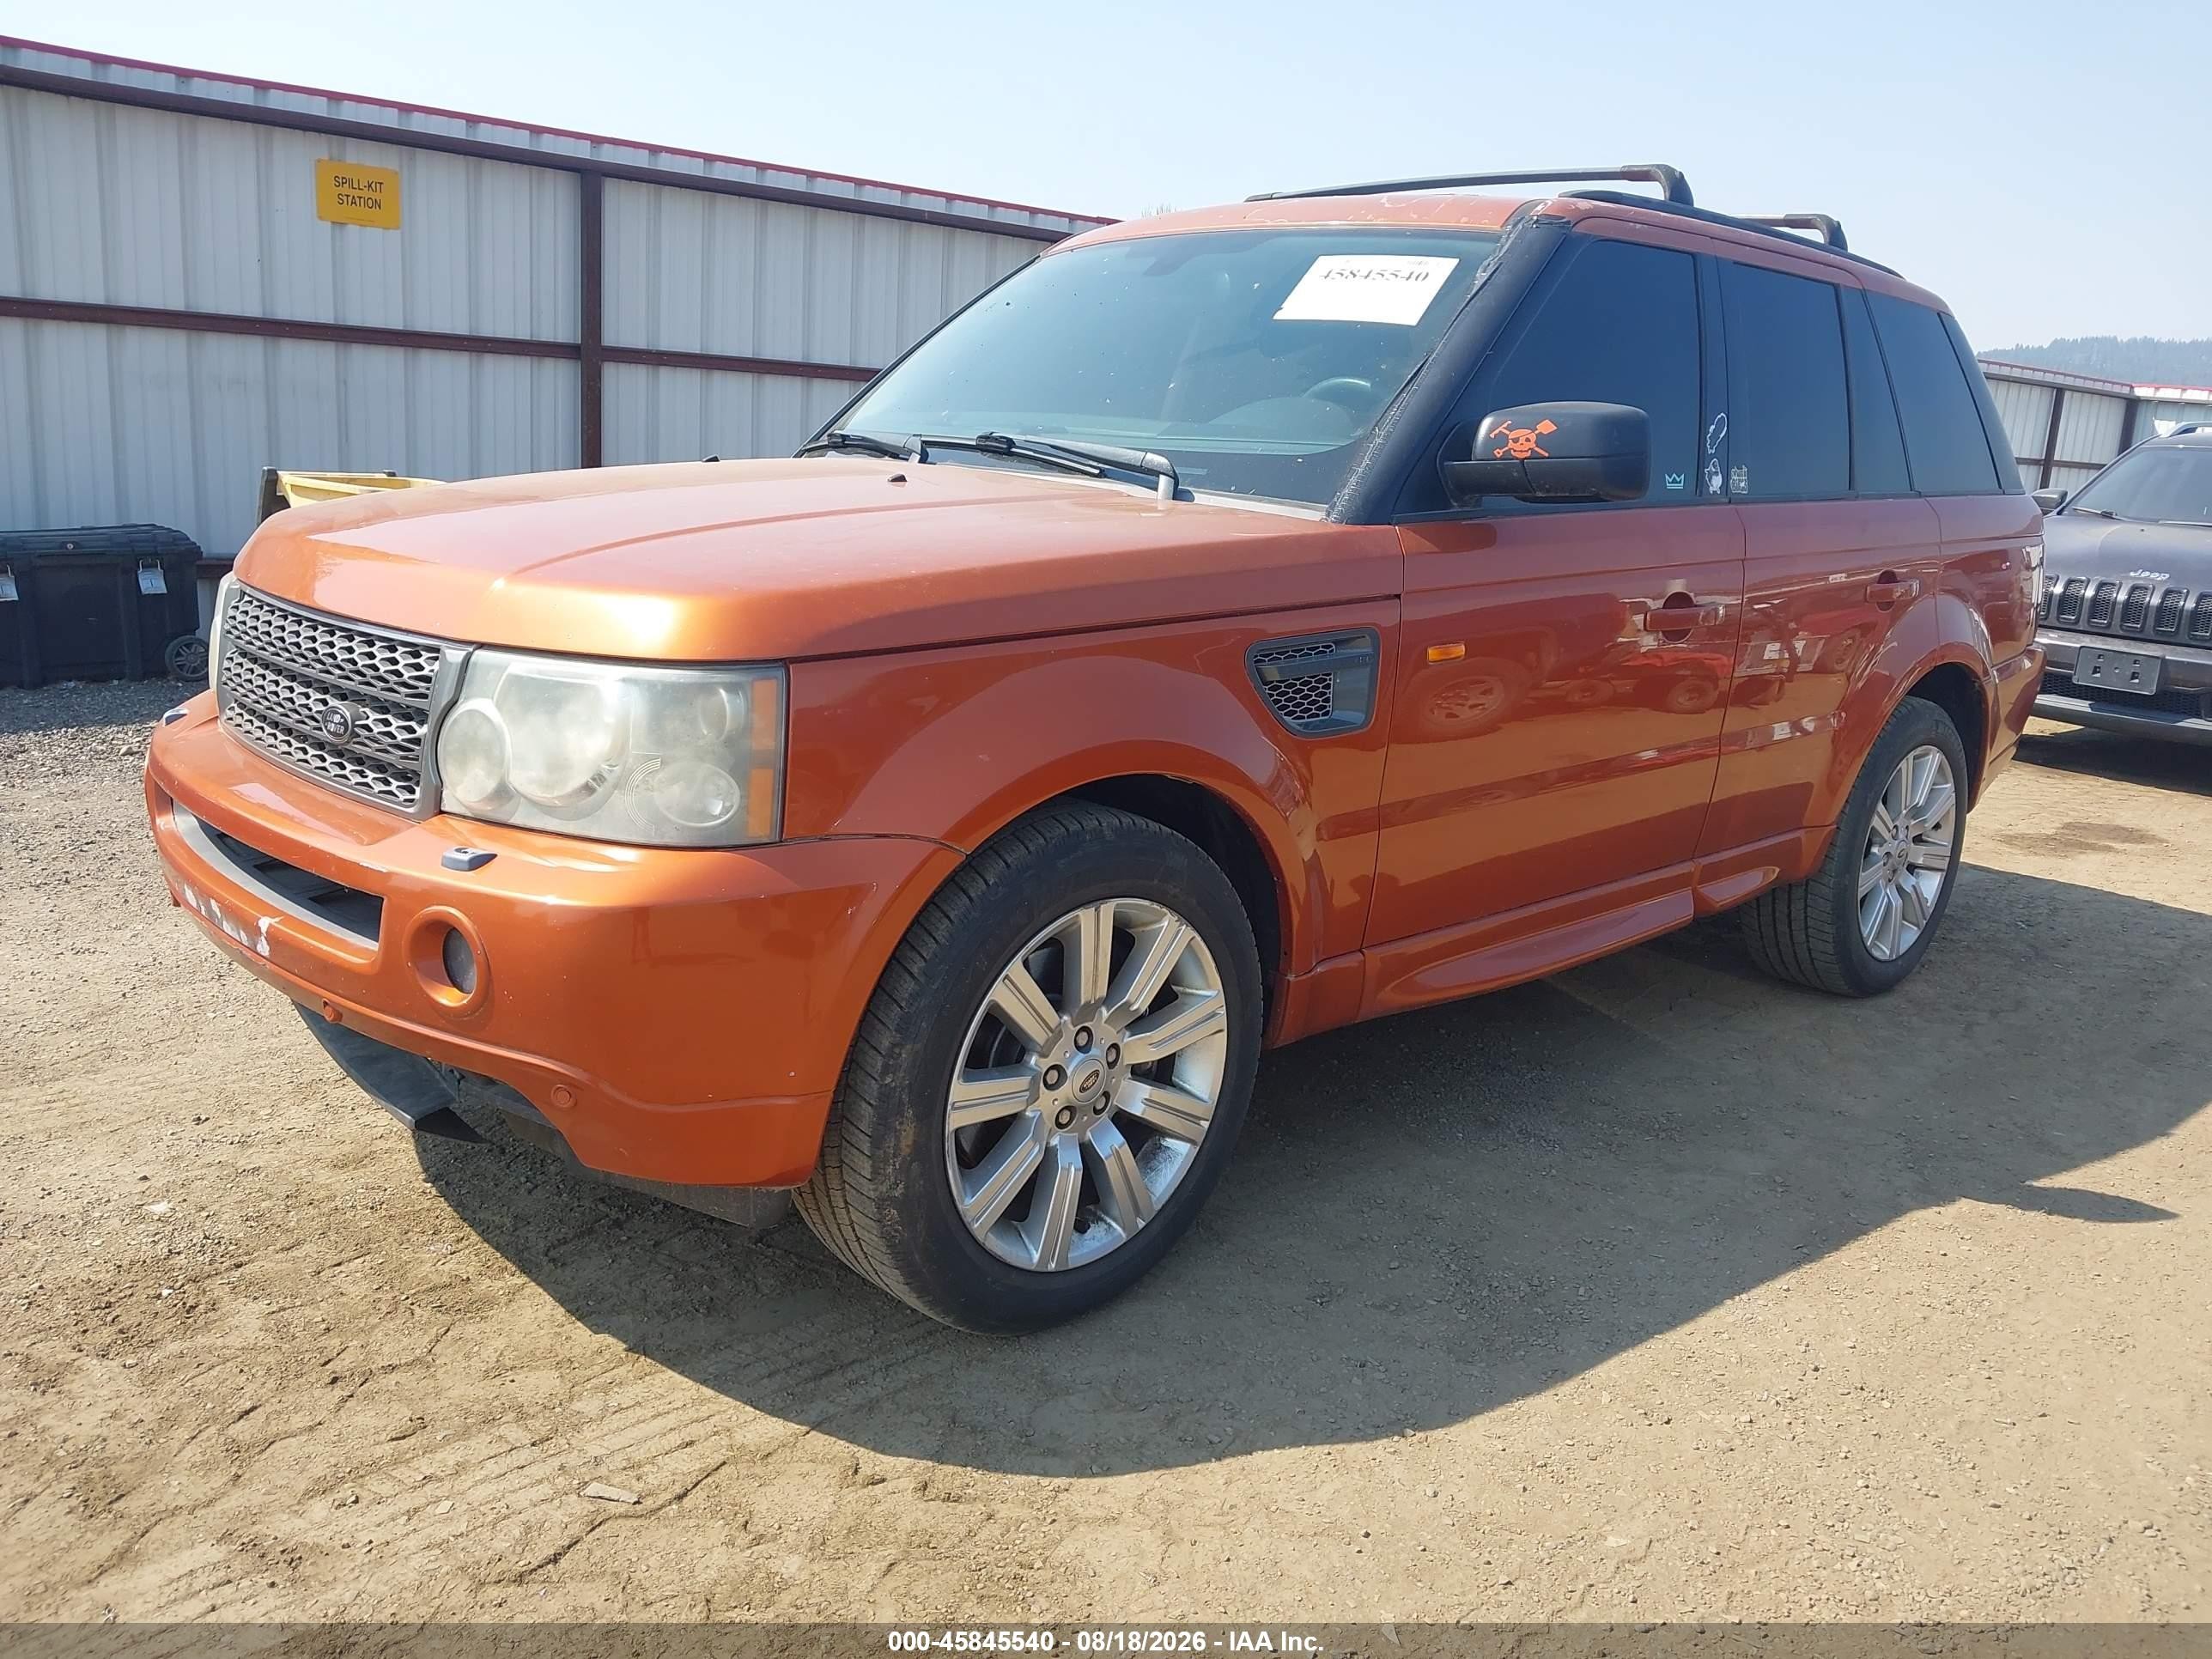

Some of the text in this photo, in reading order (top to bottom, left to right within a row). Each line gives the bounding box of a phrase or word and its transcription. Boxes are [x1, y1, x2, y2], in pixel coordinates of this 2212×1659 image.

[333, 175, 384, 193] SPILL-KIT
[337, 193, 382, 210] STATION
[1319, 268, 1430, 282] 45845540
[2130, 568, 2170, 581] Jeep
